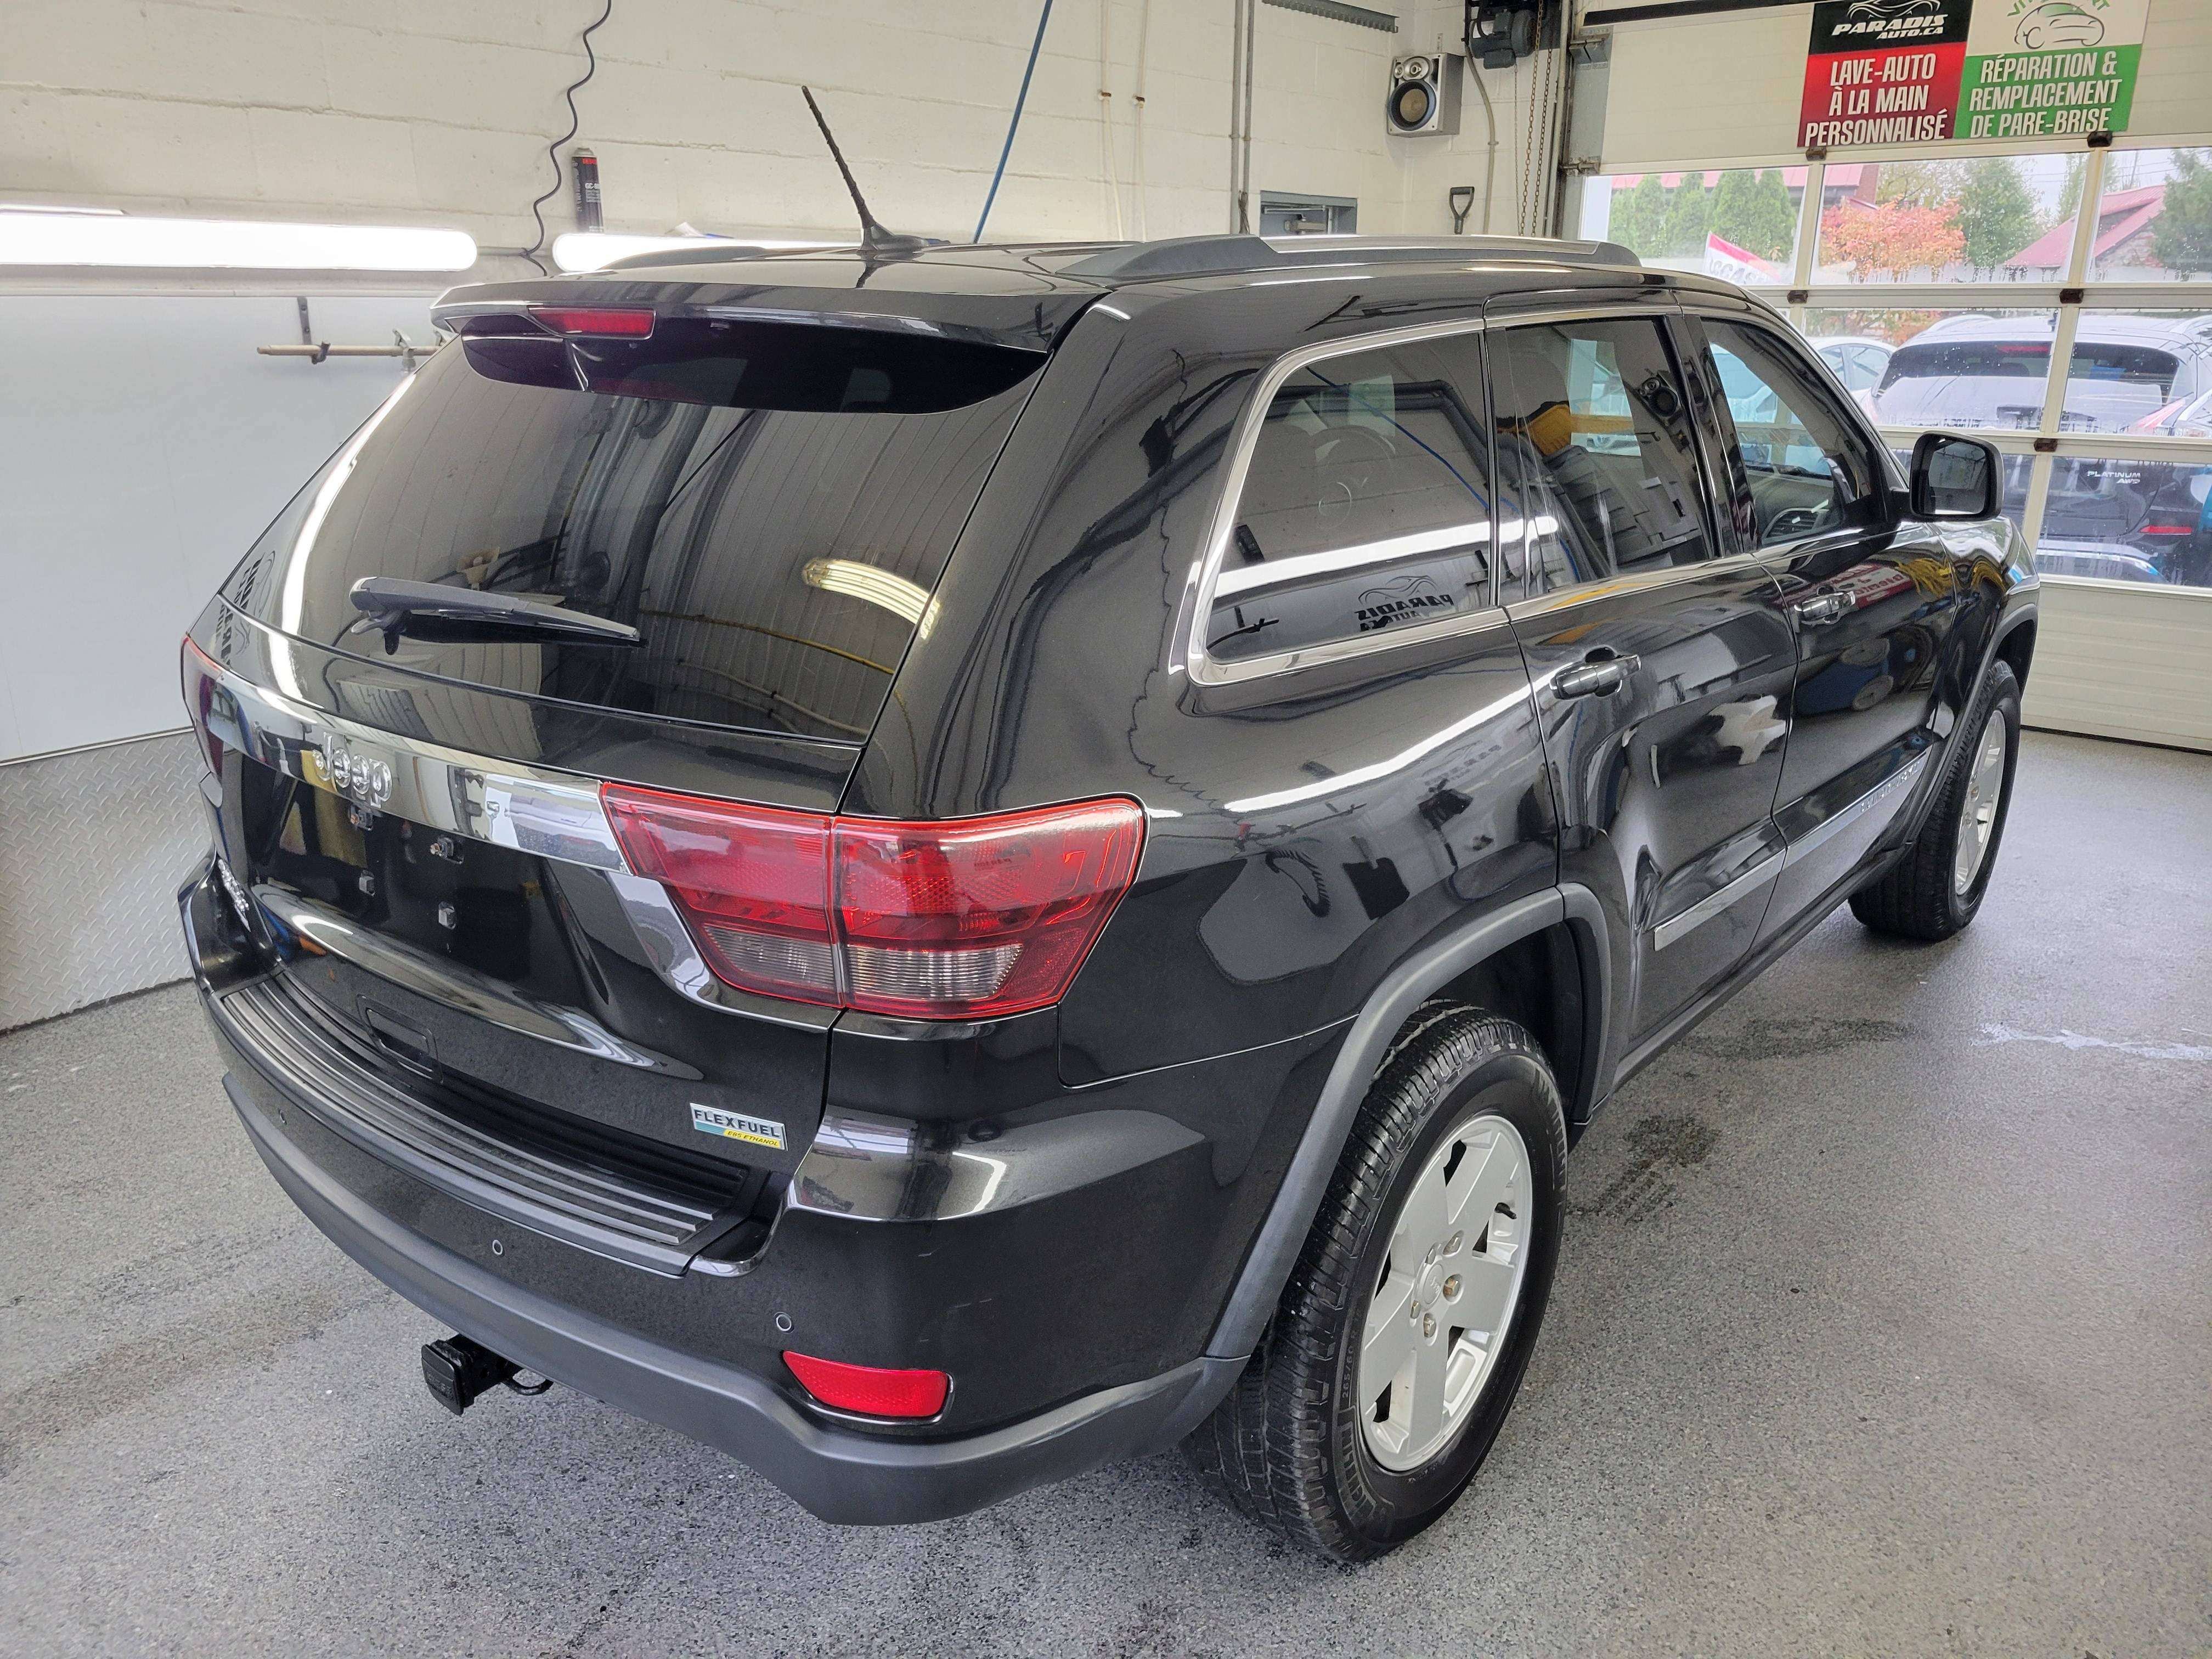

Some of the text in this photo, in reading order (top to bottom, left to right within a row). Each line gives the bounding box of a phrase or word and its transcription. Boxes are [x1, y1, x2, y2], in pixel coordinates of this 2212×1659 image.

[1831, 14, 1948, 36] PARADIS
[1876, 27, 1943, 40] AUTO.CA
[1830, 53, 1936, 86] LAVE-AUTO
[1980, 51, 2117, 83] RÉPARATION &
[1829, 85, 1929, 116] À LA MAIN
[1970, 79, 2122, 111] REMPLACEMENT
[1805, 109, 1948, 146] PERSONNALISÉ
[1970, 108, 2112, 138] DE PARE-BRISE
[312, 732, 392, 809] Jeep
[694, 1109, 781, 1137] FLEXFUEL
[727, 1130, 778, 1146] E85 ETHANOL
